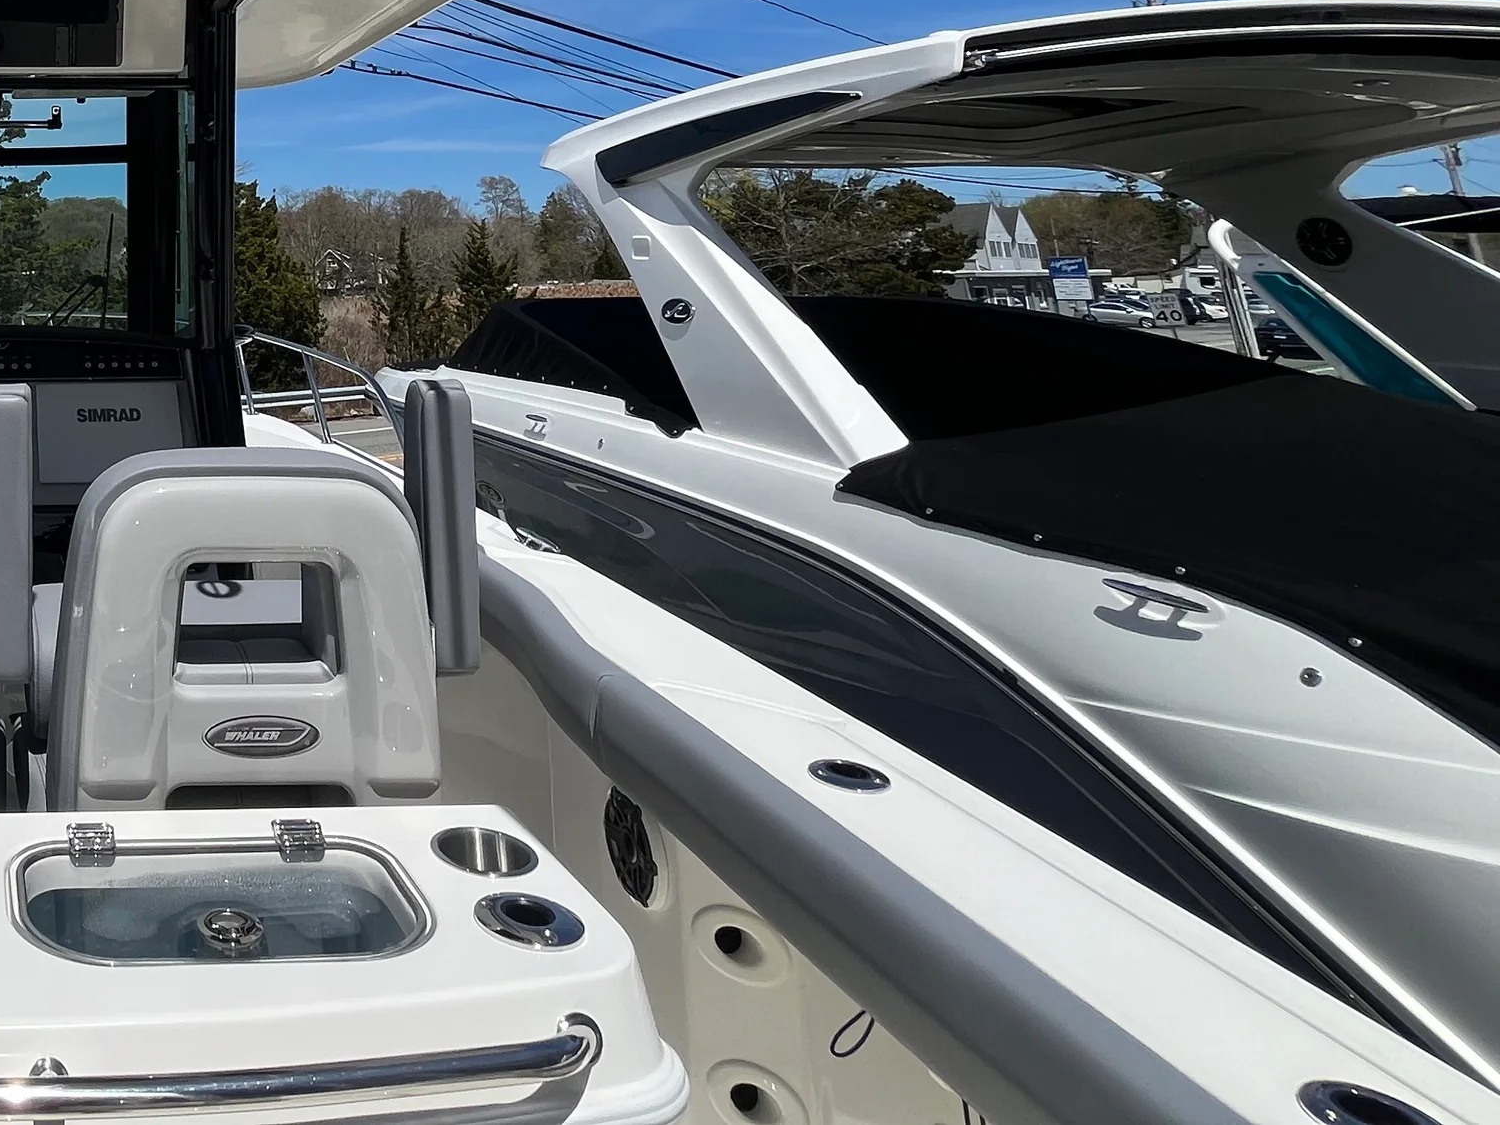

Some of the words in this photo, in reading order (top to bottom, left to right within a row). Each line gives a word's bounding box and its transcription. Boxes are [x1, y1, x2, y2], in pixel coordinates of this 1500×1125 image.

[1156, 310, 1182, 322] 40
[76, 407, 142, 423] SIMRAD
[225, 730, 281, 742] WHALER
